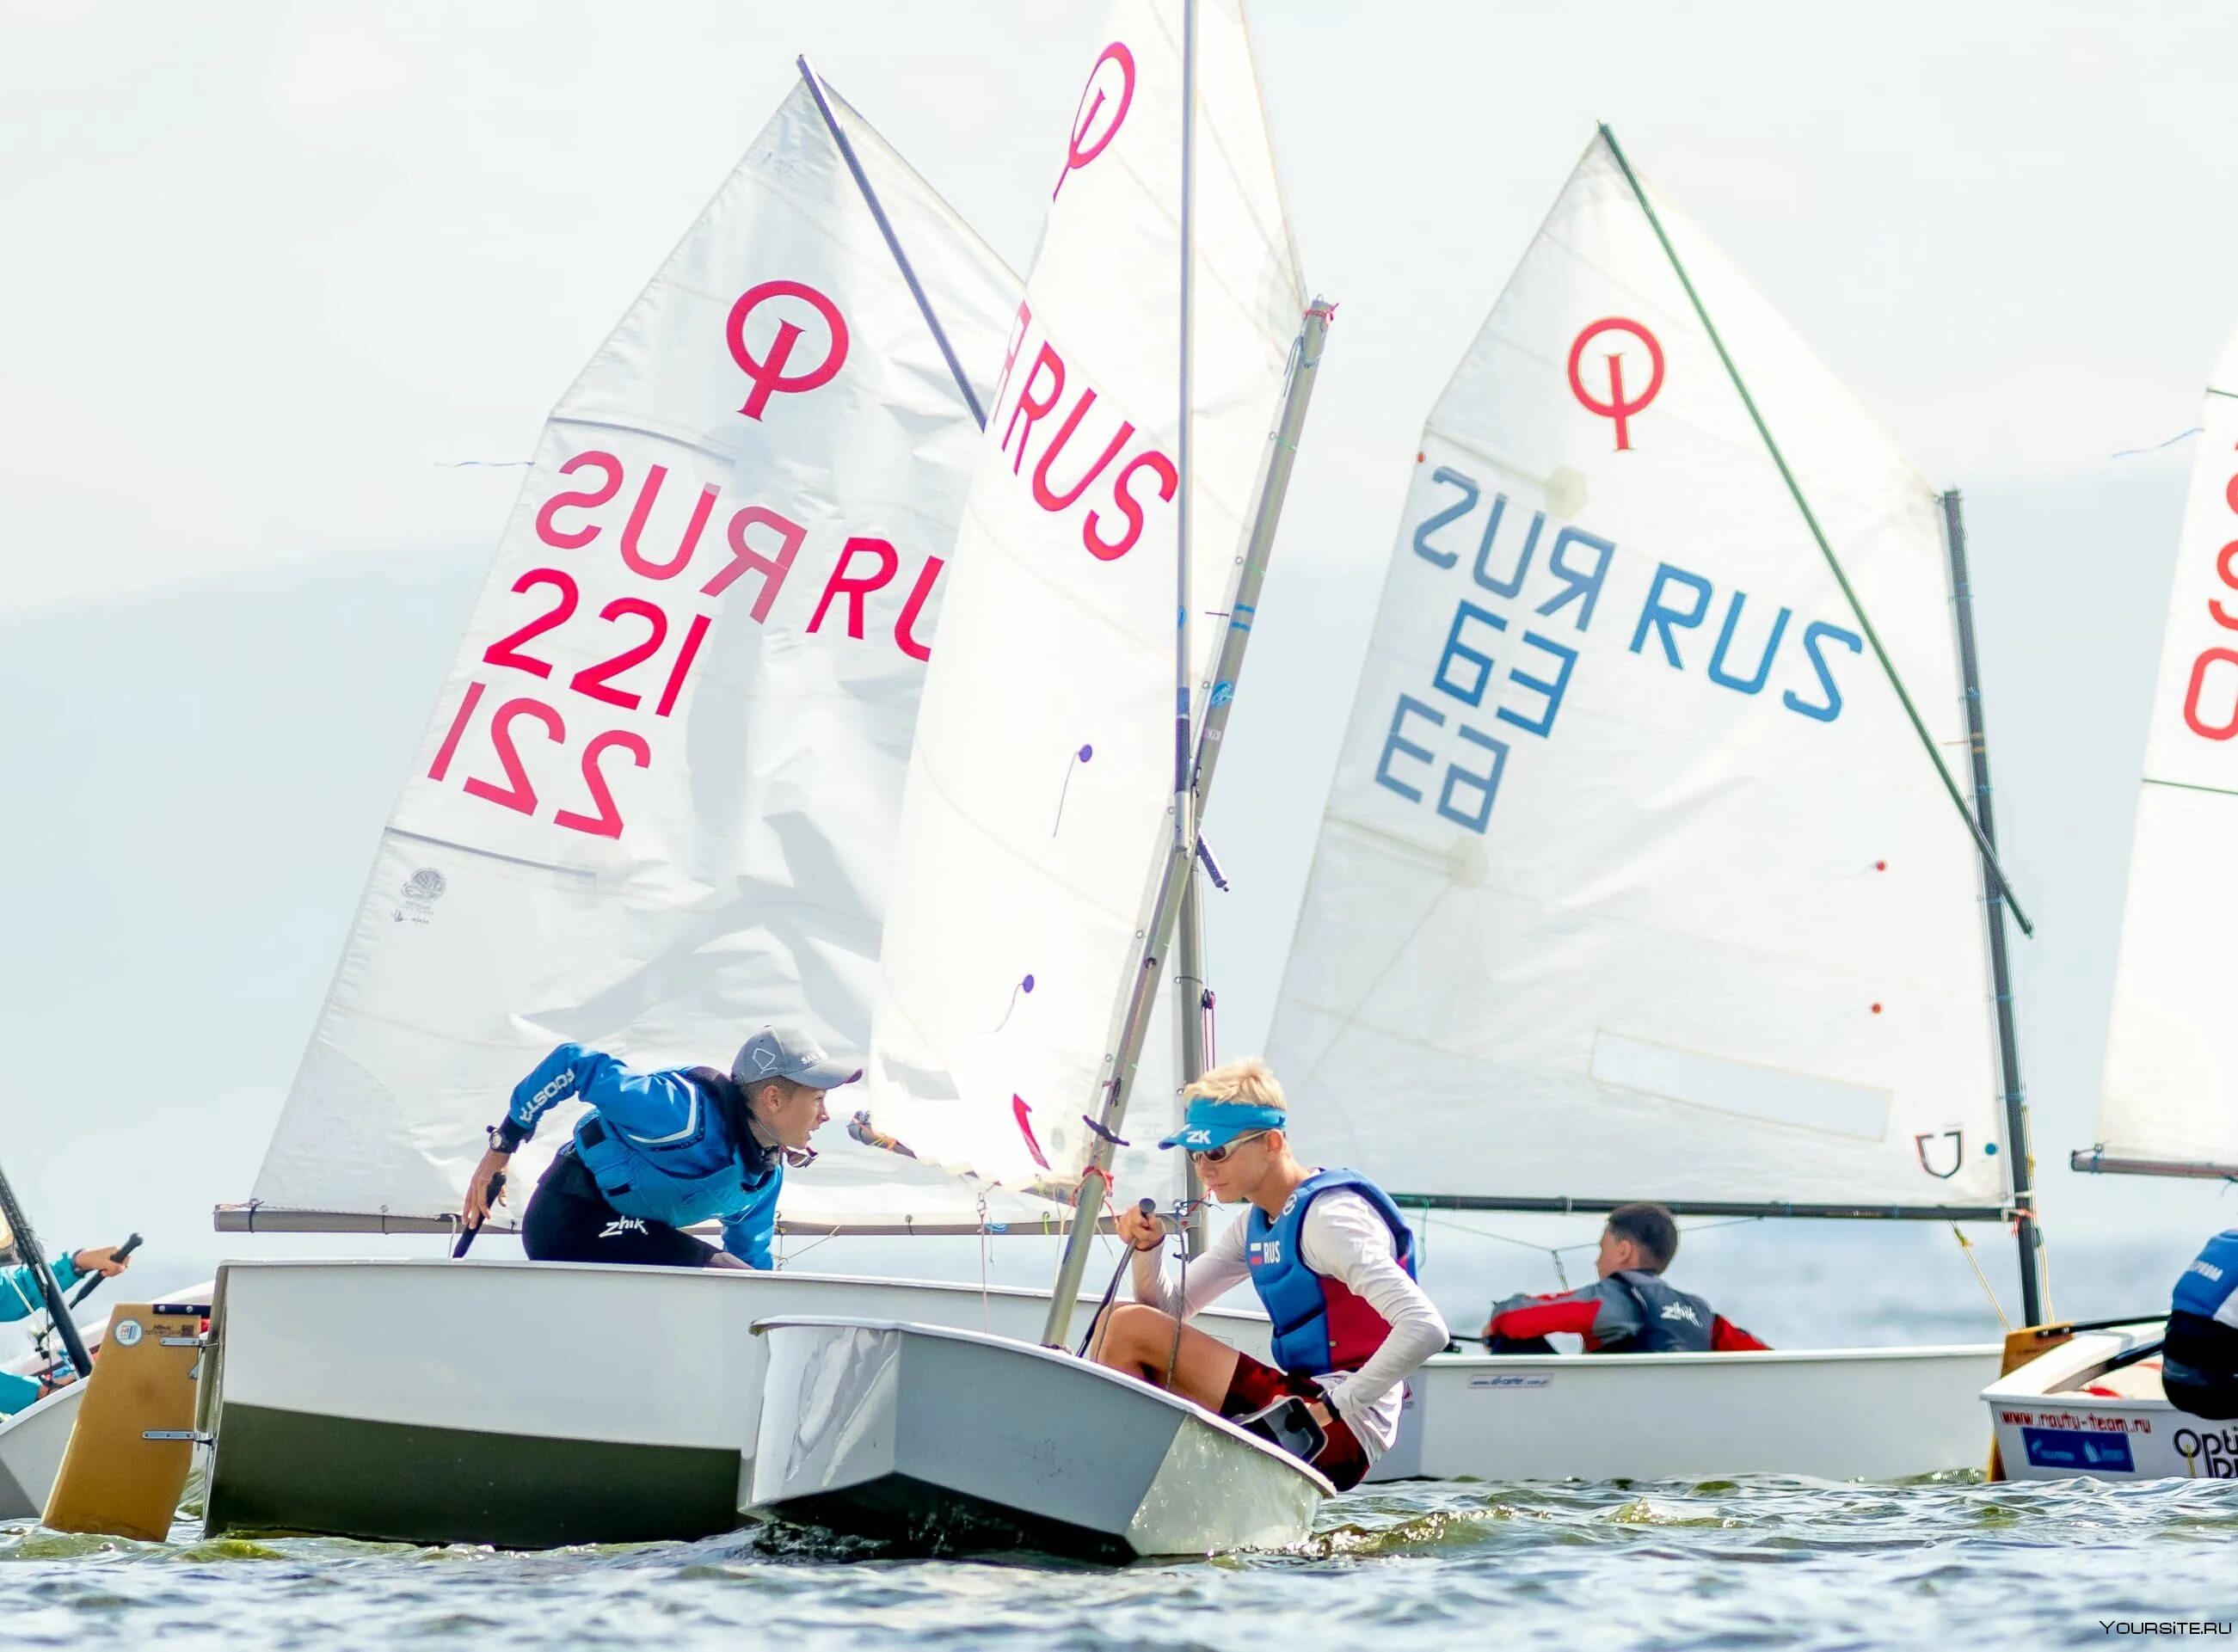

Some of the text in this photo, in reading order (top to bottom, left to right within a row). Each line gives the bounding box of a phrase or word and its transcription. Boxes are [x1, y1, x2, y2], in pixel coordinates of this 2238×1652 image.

[1001, 341, 1178, 561] RUS
[483, 568, 712, 717] 221
[1432, 599, 1579, 739] 63
[1628, 562, 1864, 723] RUS
[1263, 1240, 1281, 1264] RUS
